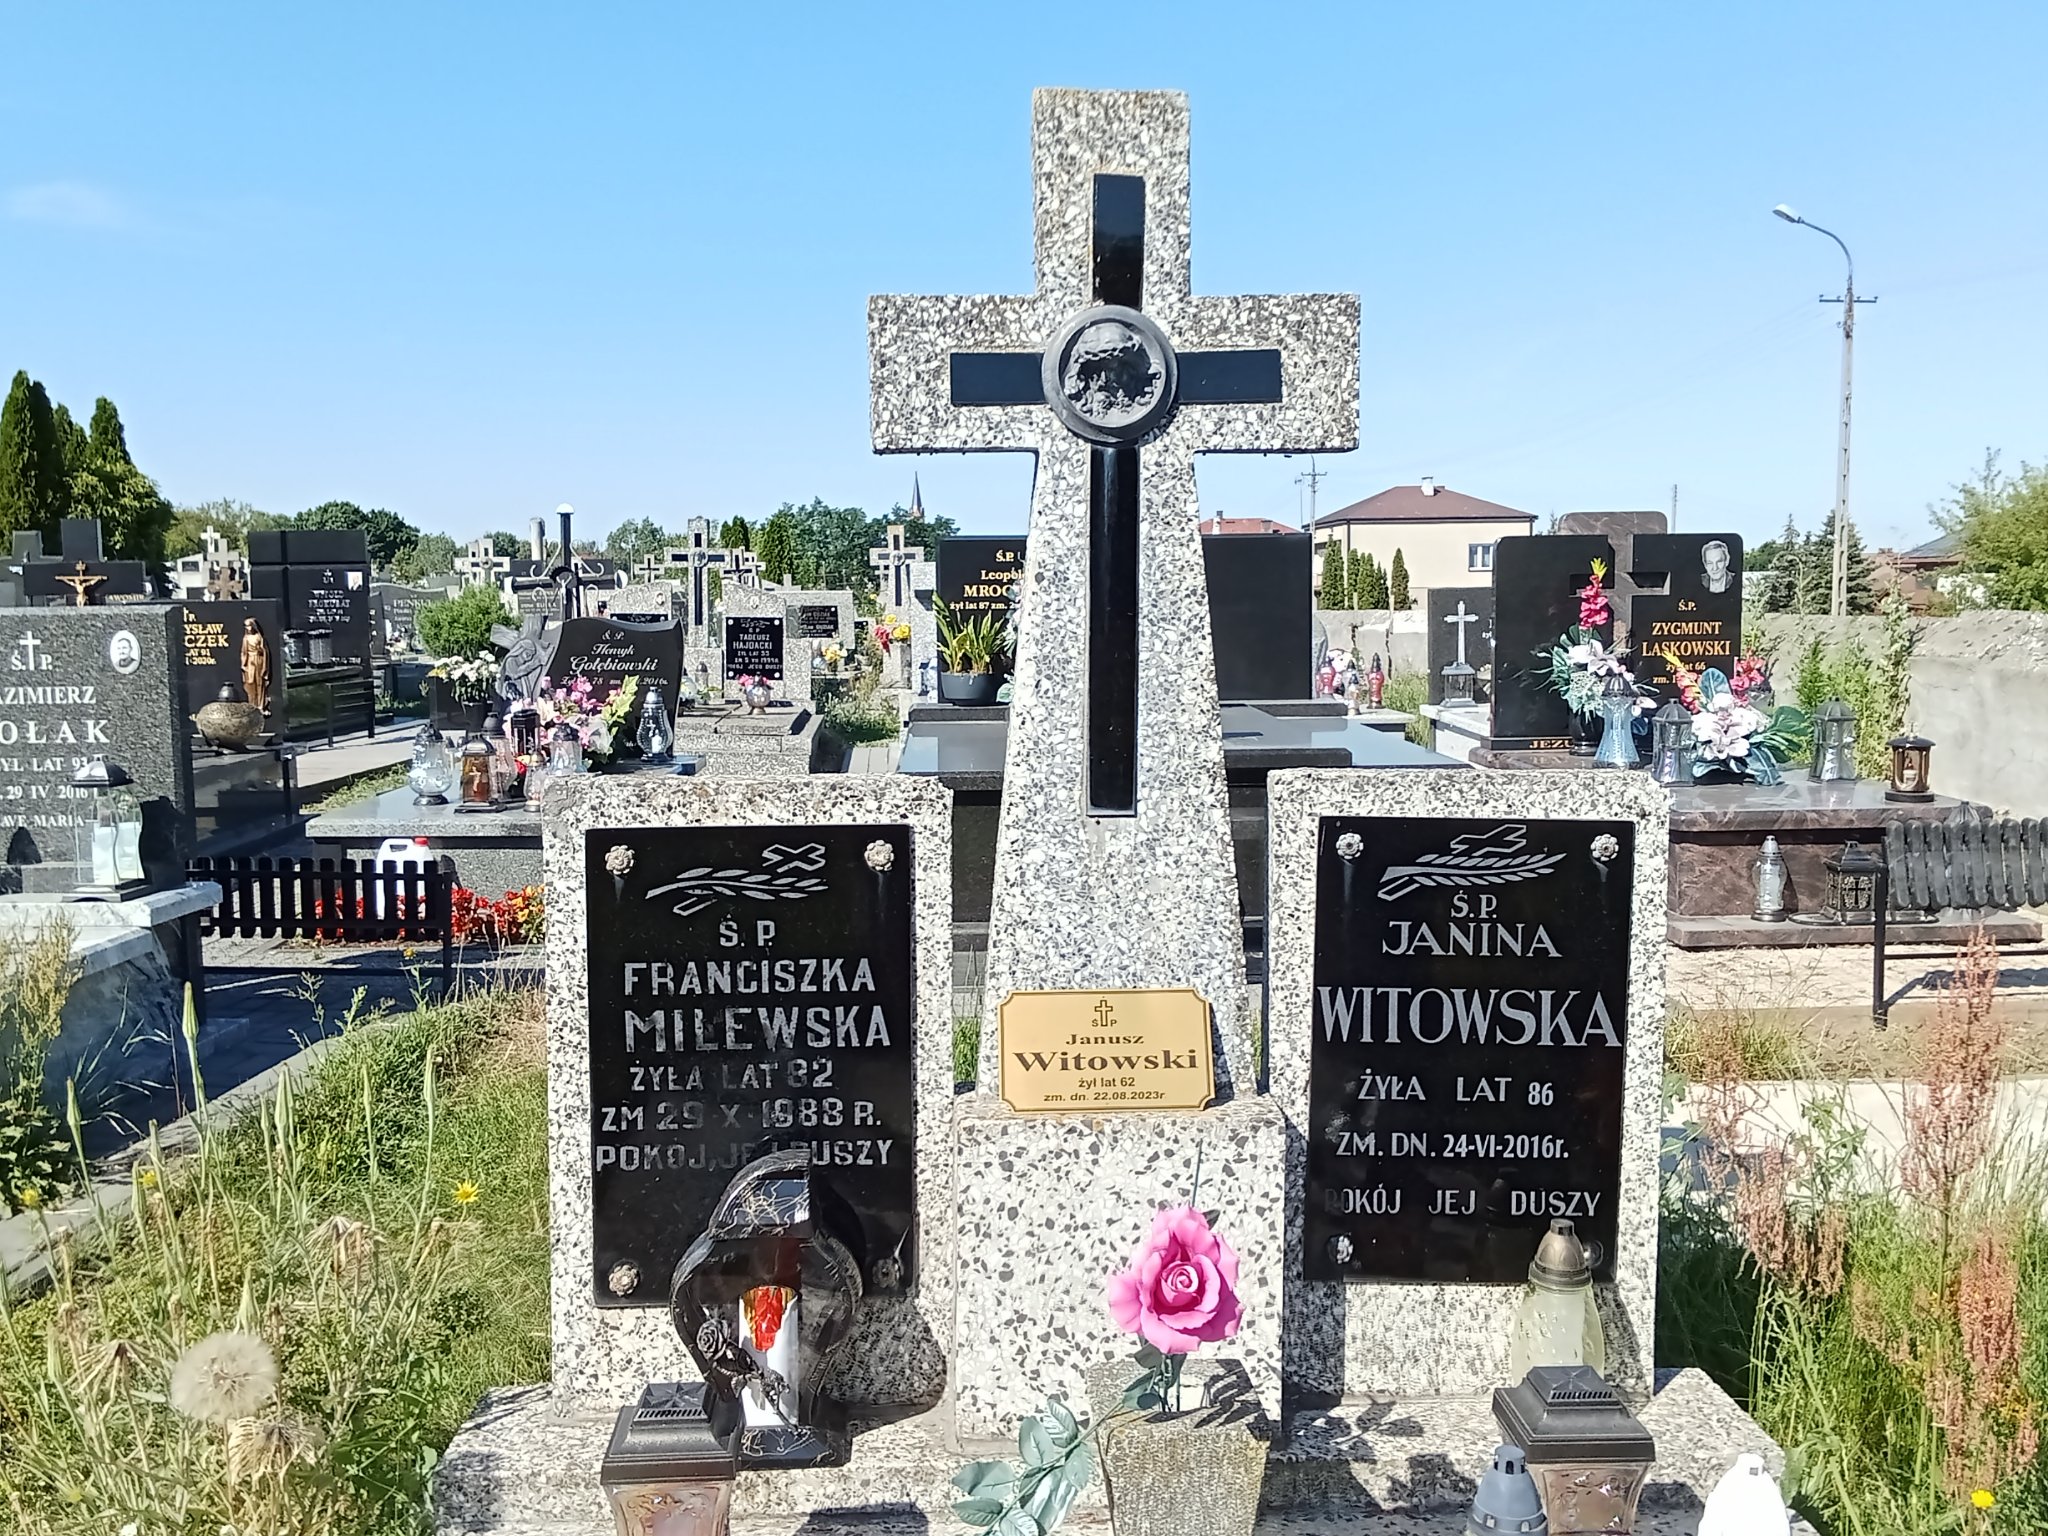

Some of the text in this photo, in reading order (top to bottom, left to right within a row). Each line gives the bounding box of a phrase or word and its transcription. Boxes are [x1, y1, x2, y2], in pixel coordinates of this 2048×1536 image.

[981, 569, 1024, 582] Leopol
[965, 602, 978, 610] lat
[979, 602, 989, 610] 87
[991, 602, 1008, 610] zm.
[1651, 621, 1723, 636] ZYGMUNT
[184, 634, 229, 648] CZEK
[739, 633, 770, 641] TADEUSZ
[200, 648, 211, 657] 91
[1642, 641, 1731, 657] LASKOWSKI
[1694, 662, 1706, 671] 66
[1653, 676, 1670, 684] zm.
[0, 685, 97, 705] ZIMIERZ
[0, 719, 111, 745] OŁAK
[32, 756, 64, 772] LAT
[6, 785, 24, 800] 29
[31, 785, 50, 800] IV
[58, 786, 89, 799] 2016
[1, 814, 84, 828] AVE MARIA
[1382, 920, 1563, 958] JANINA
[623, 957, 876, 997] FRANCISZKA
[1316, 985, 1623, 1048] WITOWSKA
[624, 1004, 891, 1053] MILEWSKA
[1065, 1033, 1145, 1045] Janusz
[1013, 1048, 1199, 1072] Witowski
[629, 1056, 833, 1092] ŻYŁA LAT 82
[1078, 1077, 1136, 1089] żył lat 62
[1358, 1068, 1554, 1106] ŻYŁA LAT 86
[1043, 1091, 1166, 1102] zm. dn. 22.08.2023r
[790, 1138, 893, 1166] USZY
[1336, 1131, 1569, 1159] ZM. DN. 24-VI-2016r.
[1428, 1189, 1476, 1215] JEJ
[1510, 1189, 1601, 1217] DUSZY
